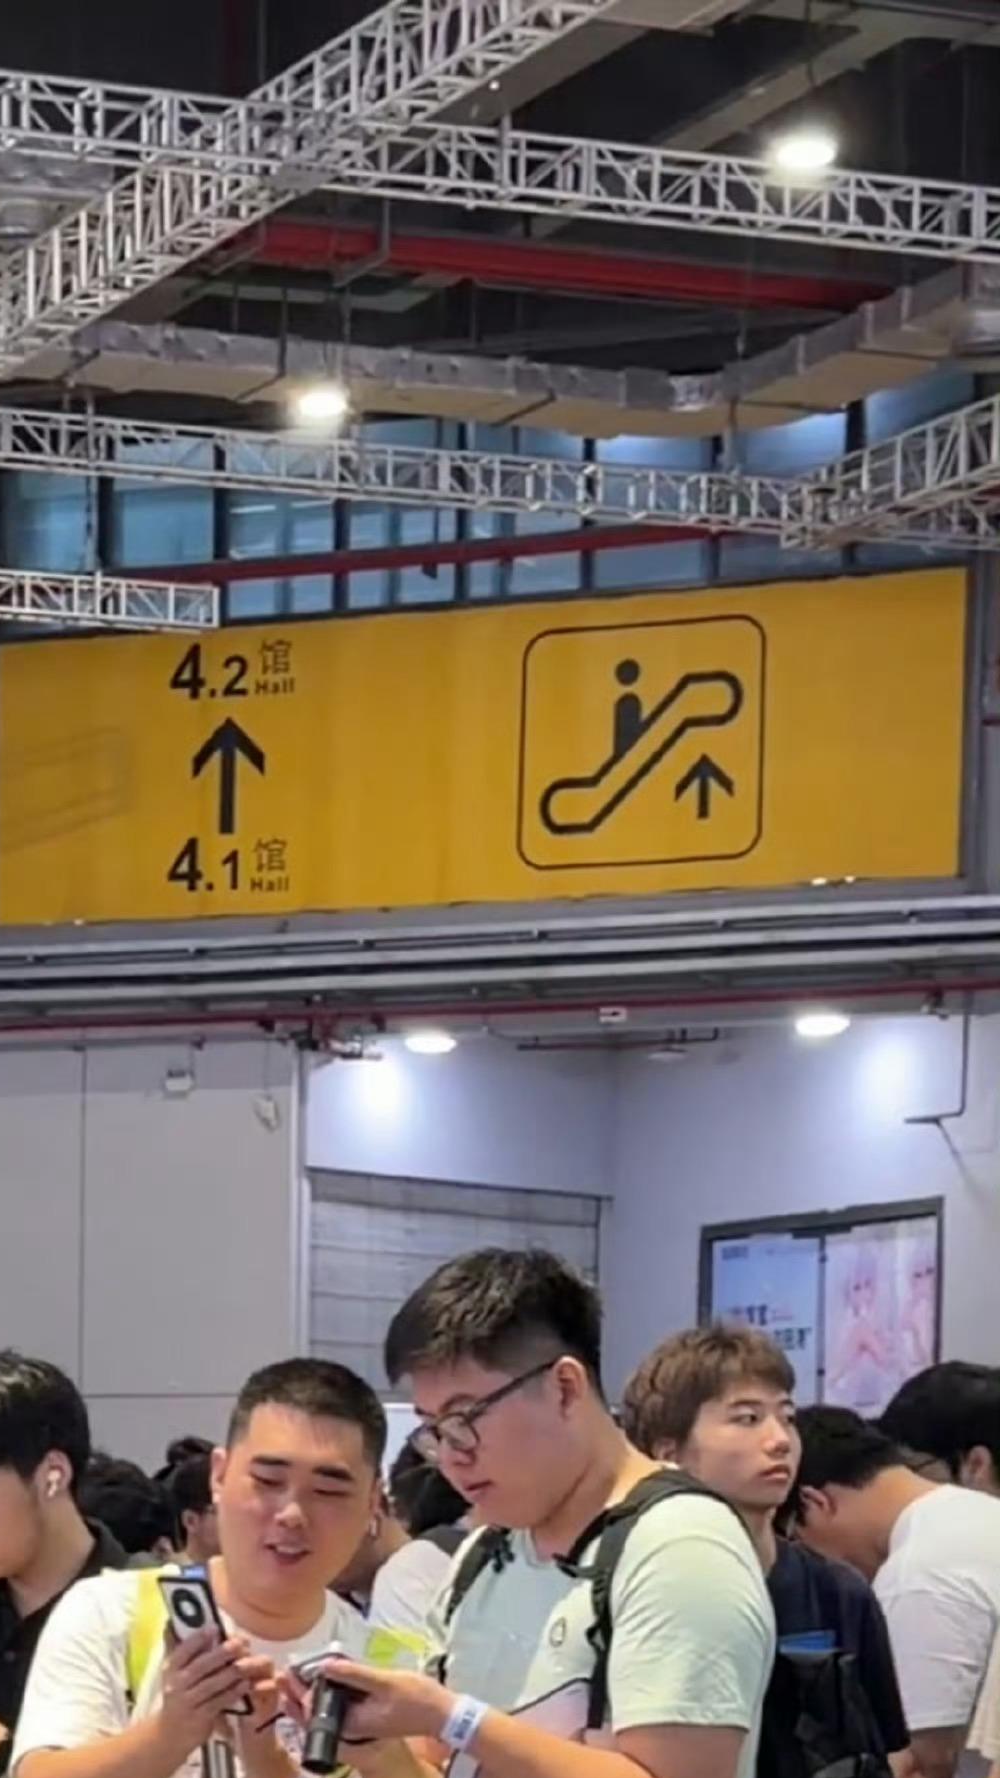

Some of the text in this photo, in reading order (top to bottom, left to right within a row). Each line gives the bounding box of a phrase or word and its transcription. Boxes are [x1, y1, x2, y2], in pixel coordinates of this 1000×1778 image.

[170, 639, 293, 700] 4.2 馆
[254, 678, 295, 694] Hall
[167, 837, 287, 891] 4.1 馆
[250, 876, 290, 892] Hall
